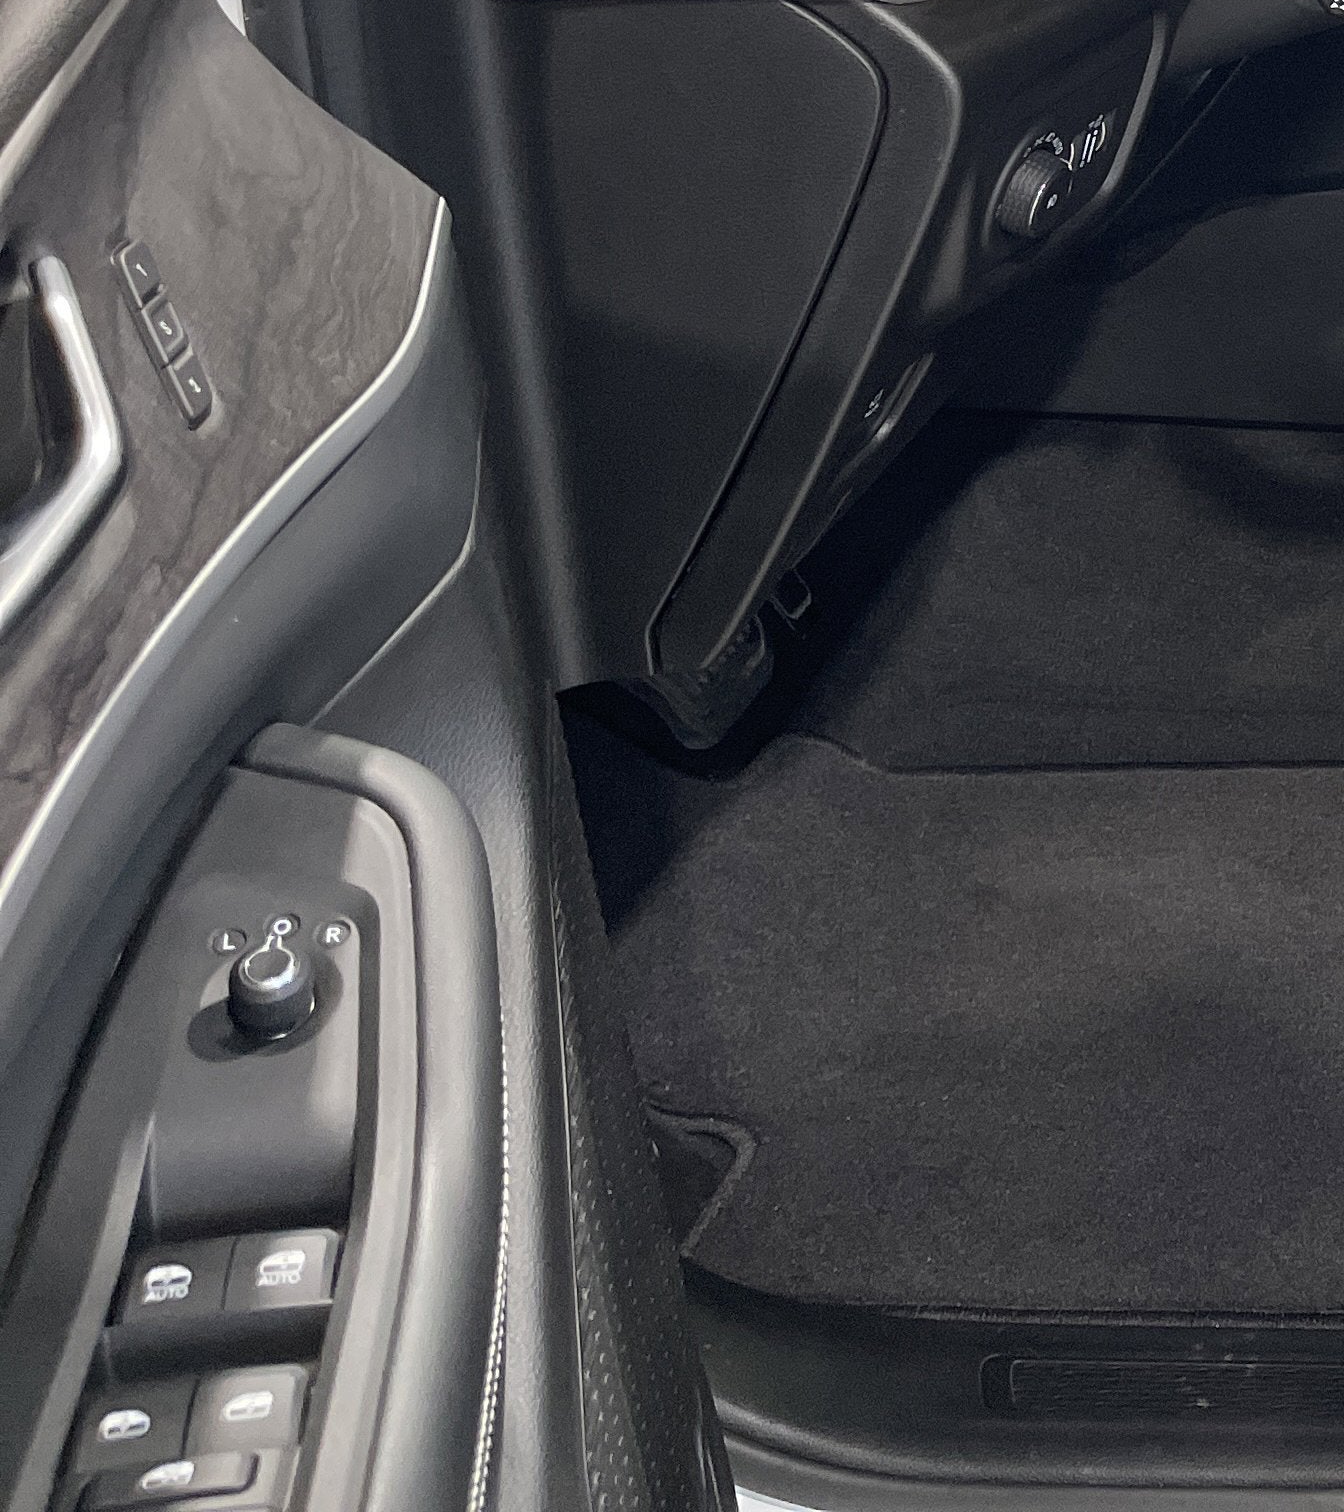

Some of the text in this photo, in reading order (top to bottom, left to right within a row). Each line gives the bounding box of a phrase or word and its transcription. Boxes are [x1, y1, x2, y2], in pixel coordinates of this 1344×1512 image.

[223, 933, 236, 950] L
[326, 927, 341, 943] R
[257, 1273, 302, 1286] AUTO
[144, 1286, 190, 1303] AUTO
